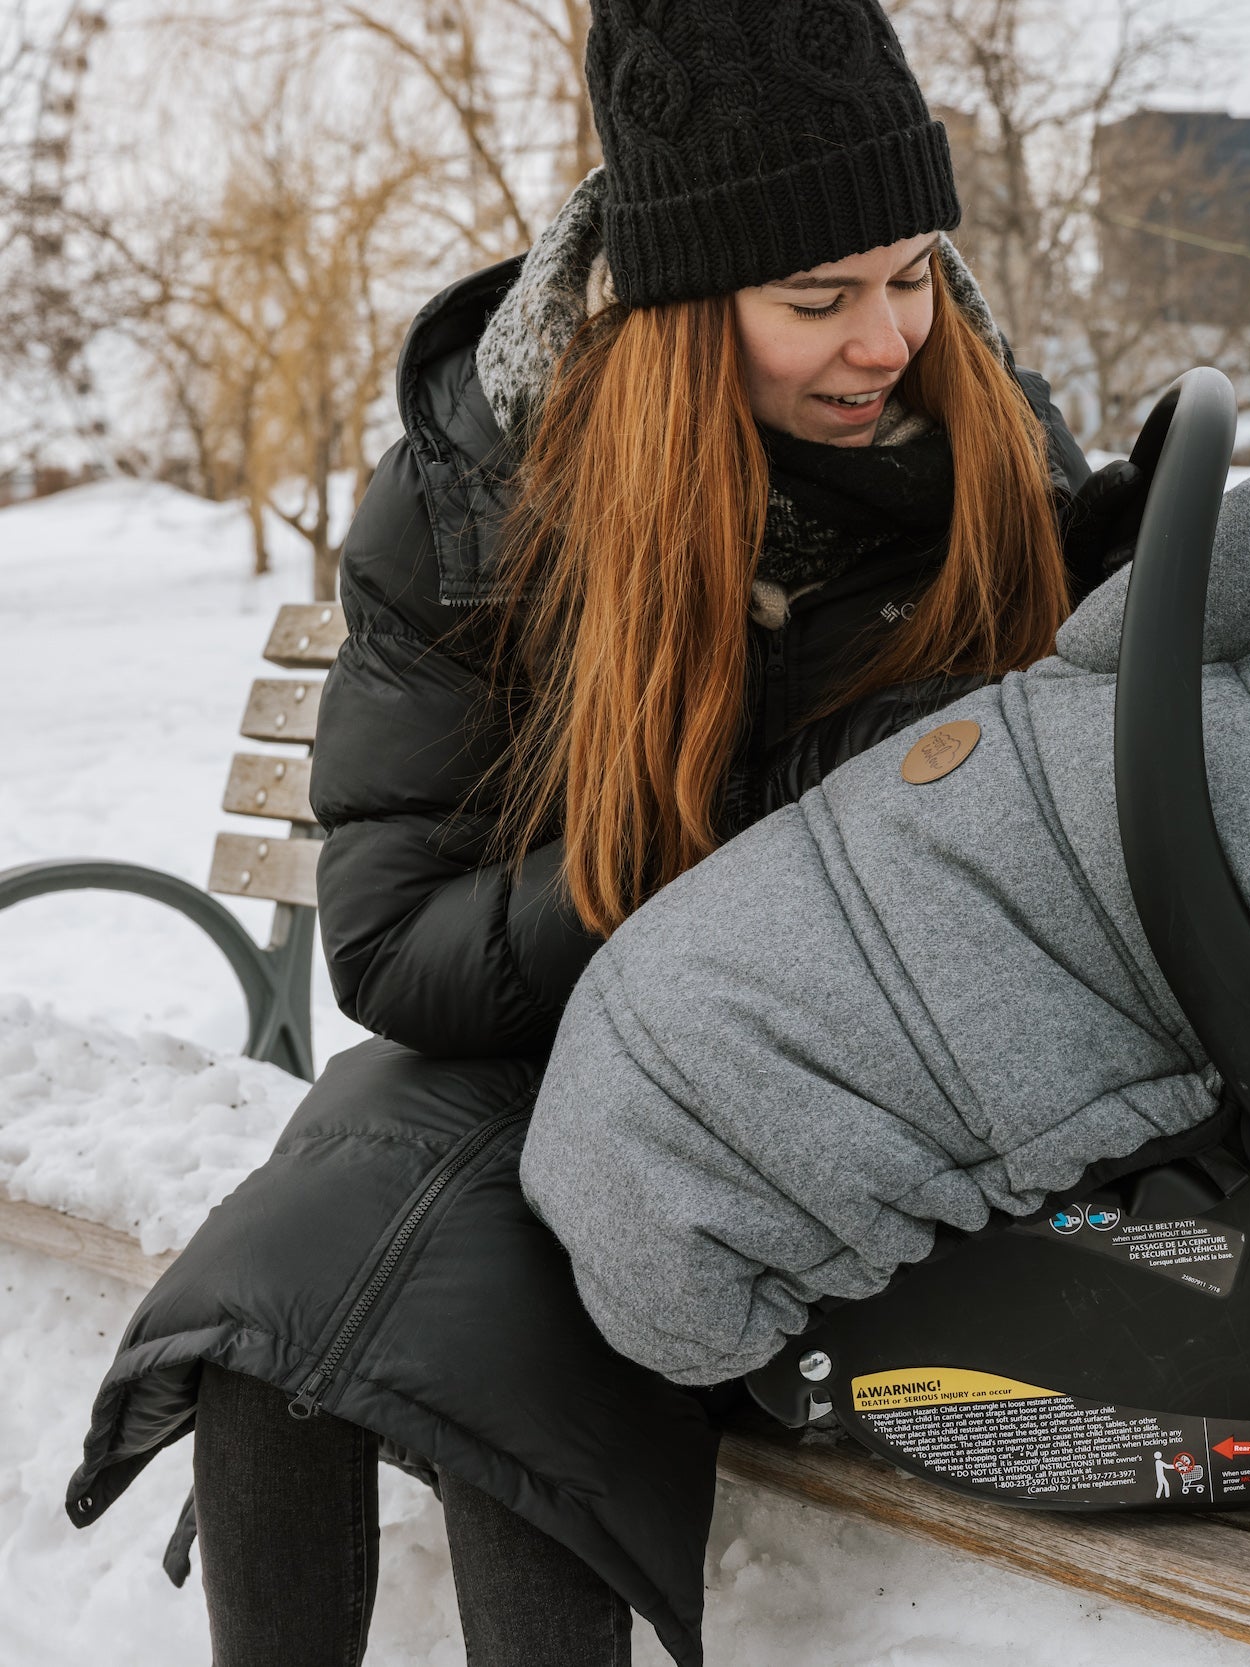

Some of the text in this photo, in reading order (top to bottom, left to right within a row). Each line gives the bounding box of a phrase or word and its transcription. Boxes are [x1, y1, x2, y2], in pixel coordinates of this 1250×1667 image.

[1122, 1224, 1153, 1233] VEHICLE
[1147, 1230, 1179, 1239] WITHOUT
[1130, 1242, 1163, 1251] PASSAGE
[1188, 1236, 1226, 1246] CEINTURE
[1141, 1248, 1176, 1258] SÉCURITÉ
[1191, 1244, 1228, 1254] VÉHICULE
[868, 1380, 941, 1398] WARNING!
[904, 1395, 938, 1403] SERIOUS
[868, 1411, 911, 1420] Strangulation
[912, 1408, 938, 1416] Hazard:
[972, 1403, 998, 1411] strangle
[1026, 1398, 1052, 1406] restraint
[1003, 1464, 1037, 1473] WITHOUT
[1039, 1459, 1094, 1470] INSTRUCTIONS!
[1047, 1468, 1083, 1477] ParentLink
[995, 1478, 1048, 1488] 1-800-233-5921
[1050, 1476, 1070, 1484] (U.S.)
[1081, 1470, 1135, 1480] 1-937-773-3971
[1028, 1484, 1058, 1494] (Canada)
[1092, 1477, 1136, 1488] replacement.
[1224, 1484, 1246, 1492] ground.
